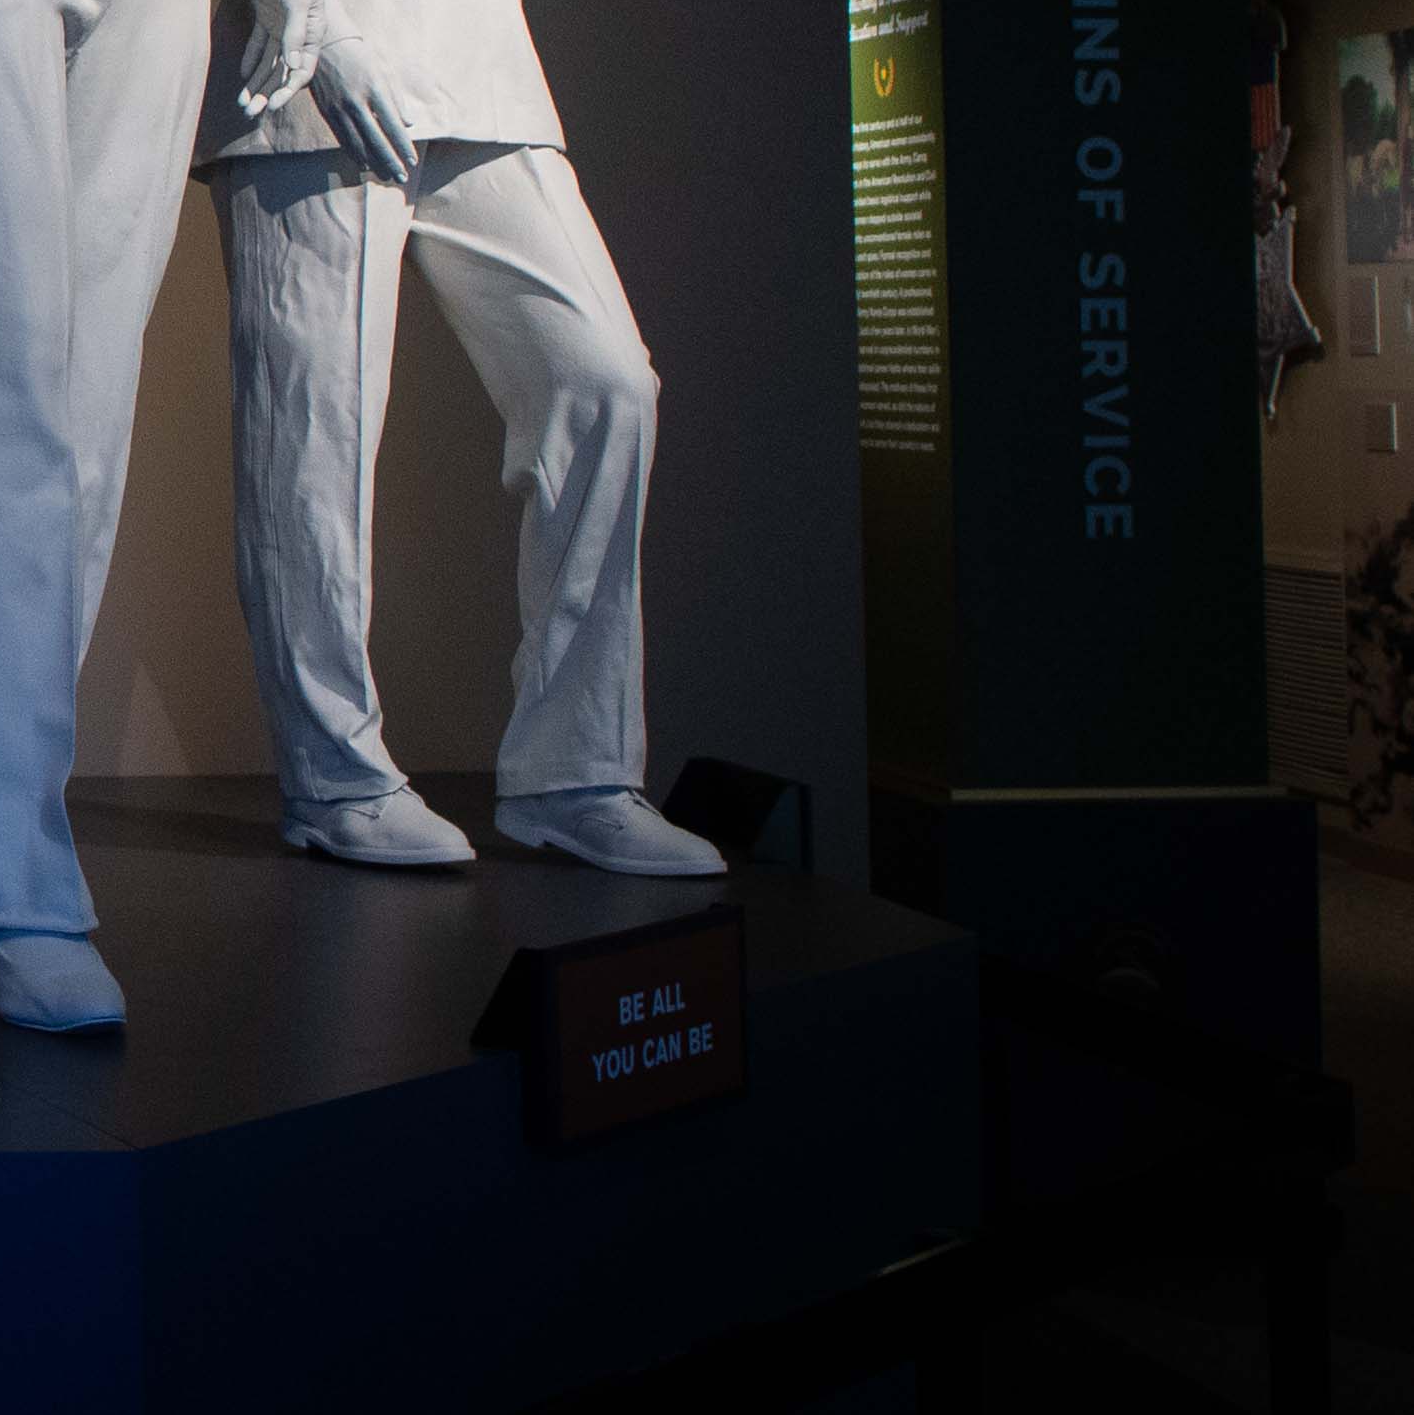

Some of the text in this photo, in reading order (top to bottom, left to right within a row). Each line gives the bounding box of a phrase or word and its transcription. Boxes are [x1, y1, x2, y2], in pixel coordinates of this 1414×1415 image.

[1075, 136, 1126, 223] OF
[1078, 251, 1135, 539] SERVICE
[619, 982, 686, 1027] BE ALL
[591, 1020, 715, 1082] YOU CAN BE
